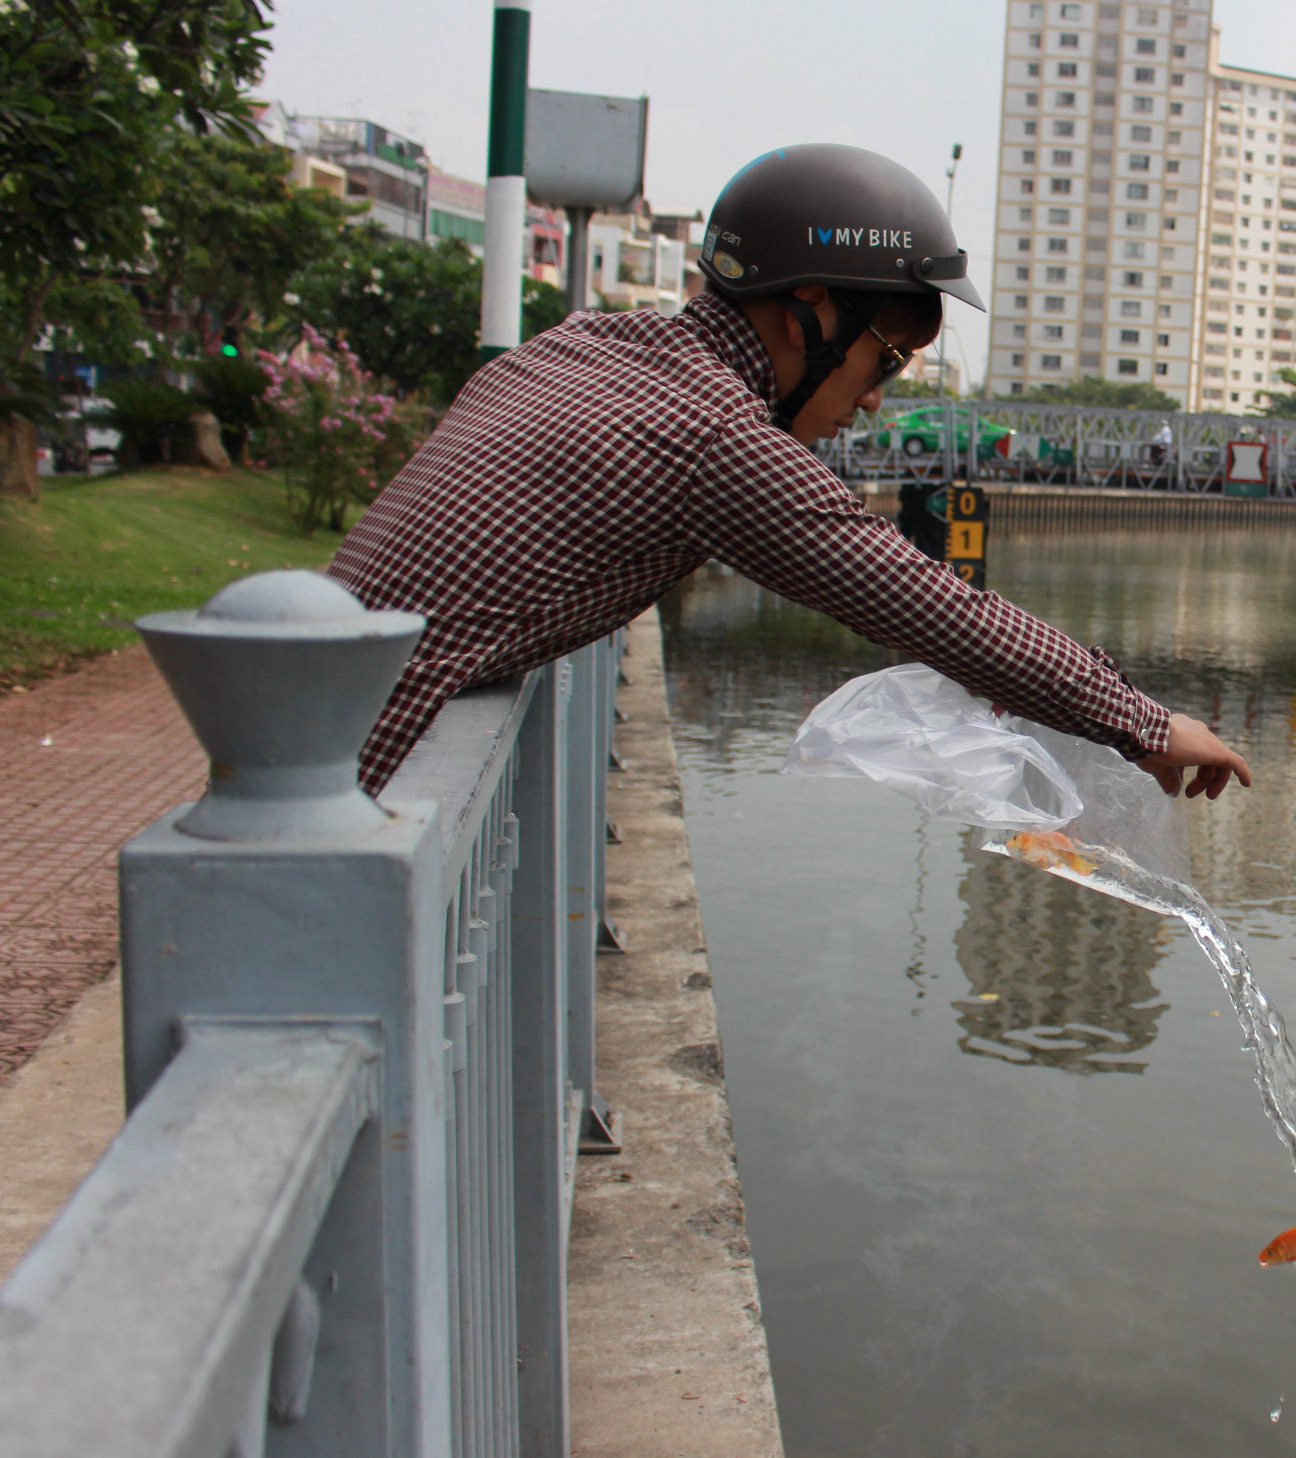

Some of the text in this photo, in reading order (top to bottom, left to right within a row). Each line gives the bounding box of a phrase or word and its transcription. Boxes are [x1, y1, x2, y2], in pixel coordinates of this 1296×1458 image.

[722, 231, 741, 247] can
[808, 226, 912, 249] I MY BIKE
[959, 491, 976, 515] 0
[960, 529, 969, 550] 1
[958, 564, 974, 583] 2
